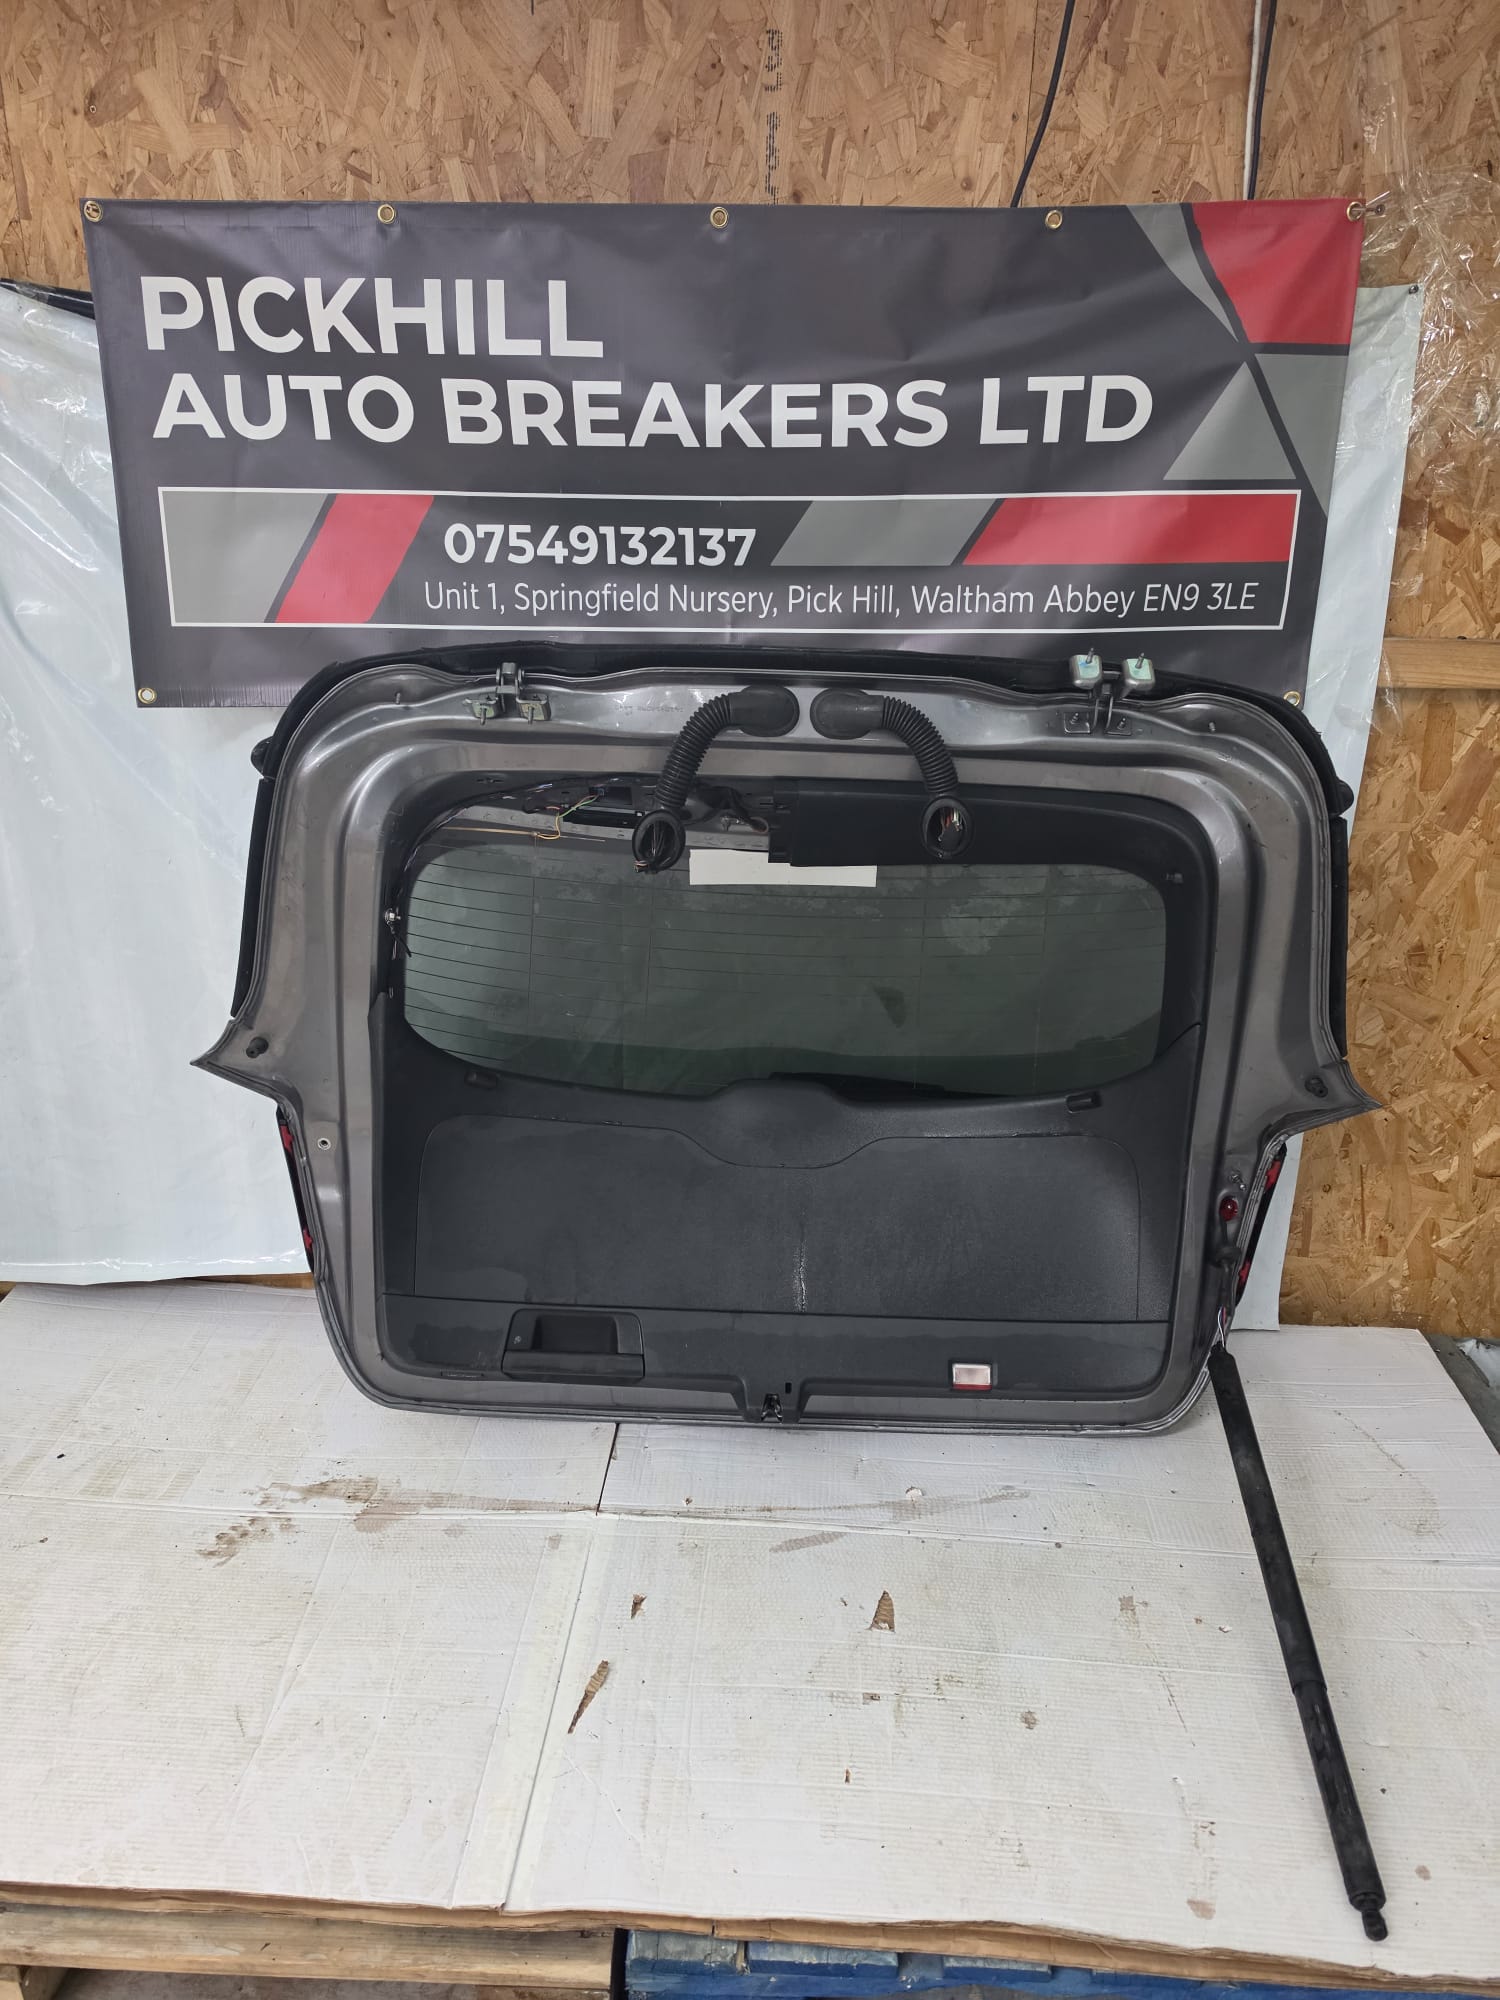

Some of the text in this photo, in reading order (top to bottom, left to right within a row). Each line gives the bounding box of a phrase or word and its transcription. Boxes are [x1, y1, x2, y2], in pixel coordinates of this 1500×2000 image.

[140, 275, 604, 358] PICKHILL
[152, 372, 1153, 449] AUTO BREAKERS LTD
[443, 522, 757, 567] 07549132137
[425, 581, 1260, 619] Unit 1, Springfield Nursery, Pick Hill, Waltham Abbey EN9 3LE
